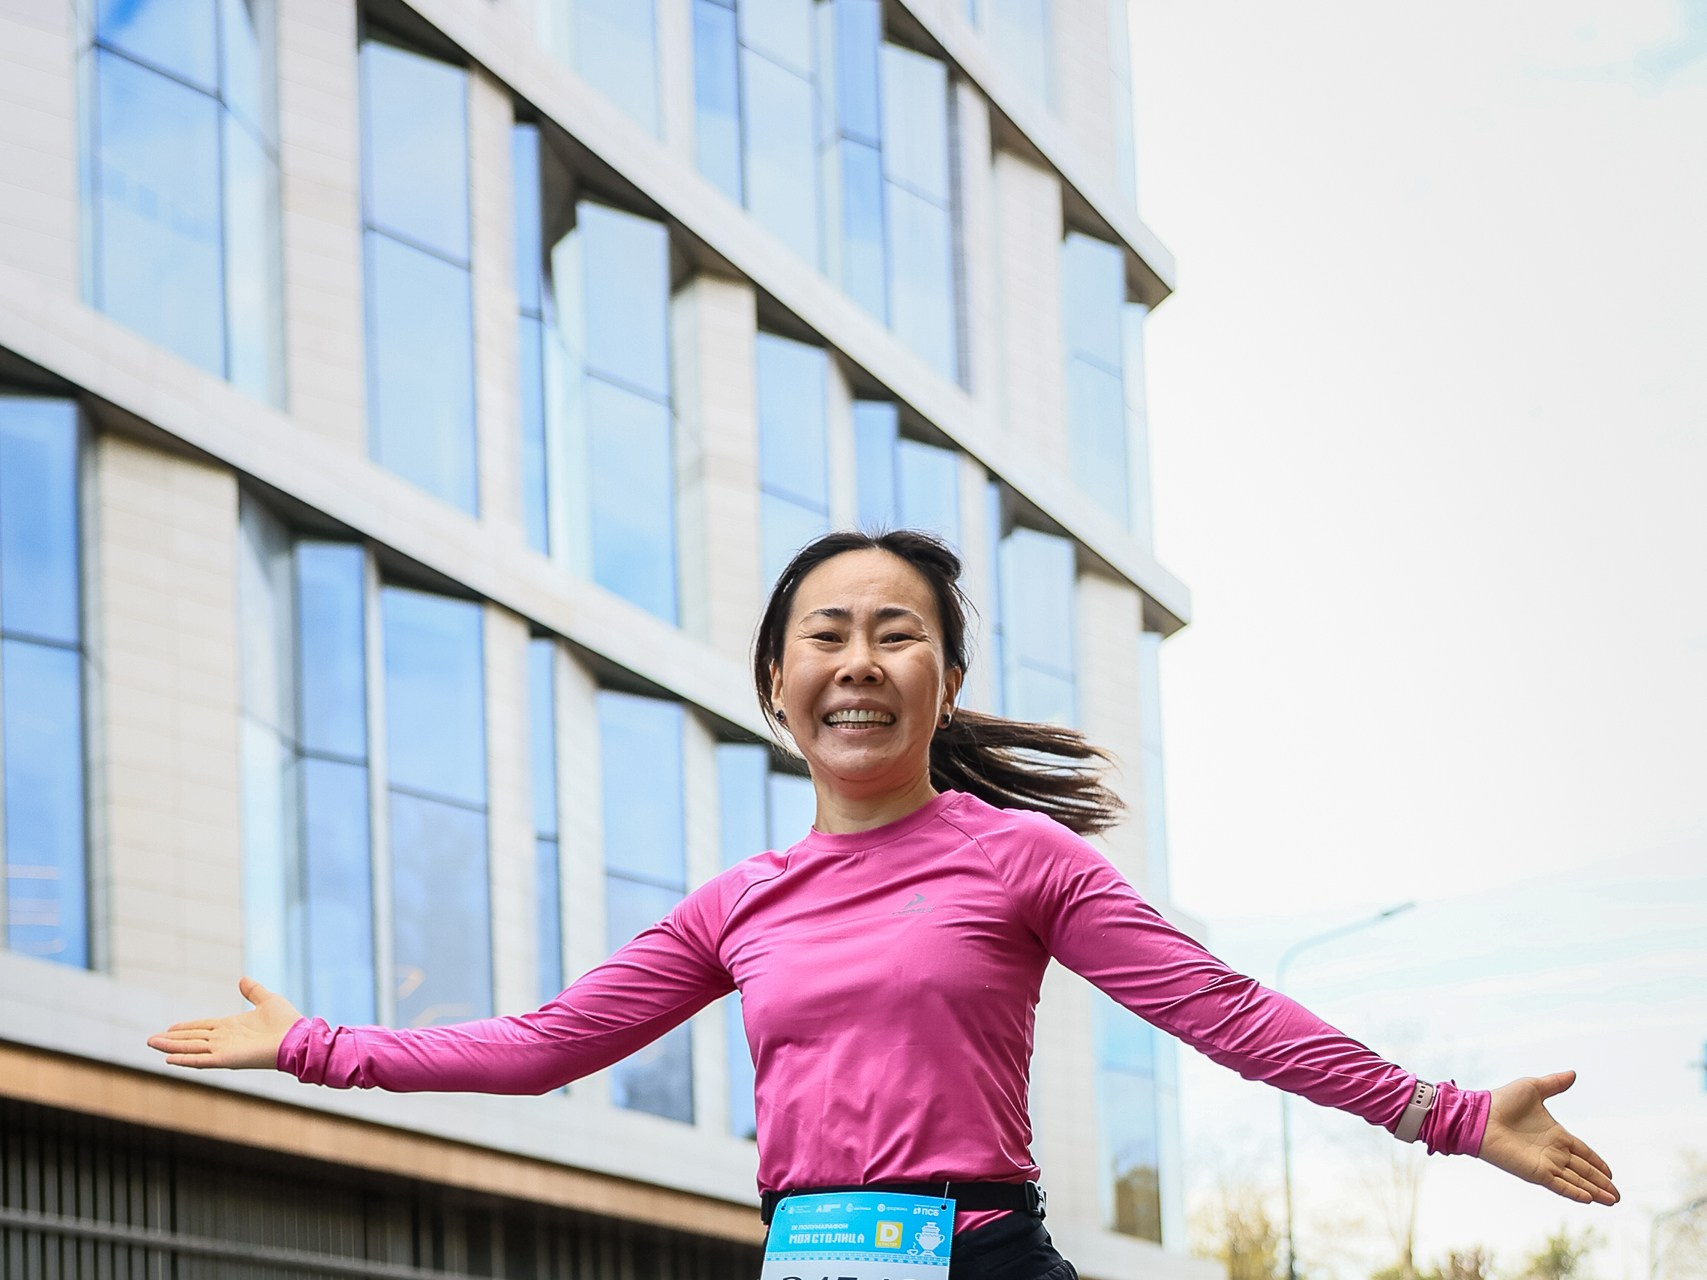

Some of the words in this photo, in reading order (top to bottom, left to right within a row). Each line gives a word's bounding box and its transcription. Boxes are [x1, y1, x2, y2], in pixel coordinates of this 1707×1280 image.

[921, 1207, 940, 1217] ПСБ
[789, 1233, 811, 1245] МОЯ
[812, 1232, 865, 1244] СТОЛИЦА
[879, 1223, 899, 1243] D
